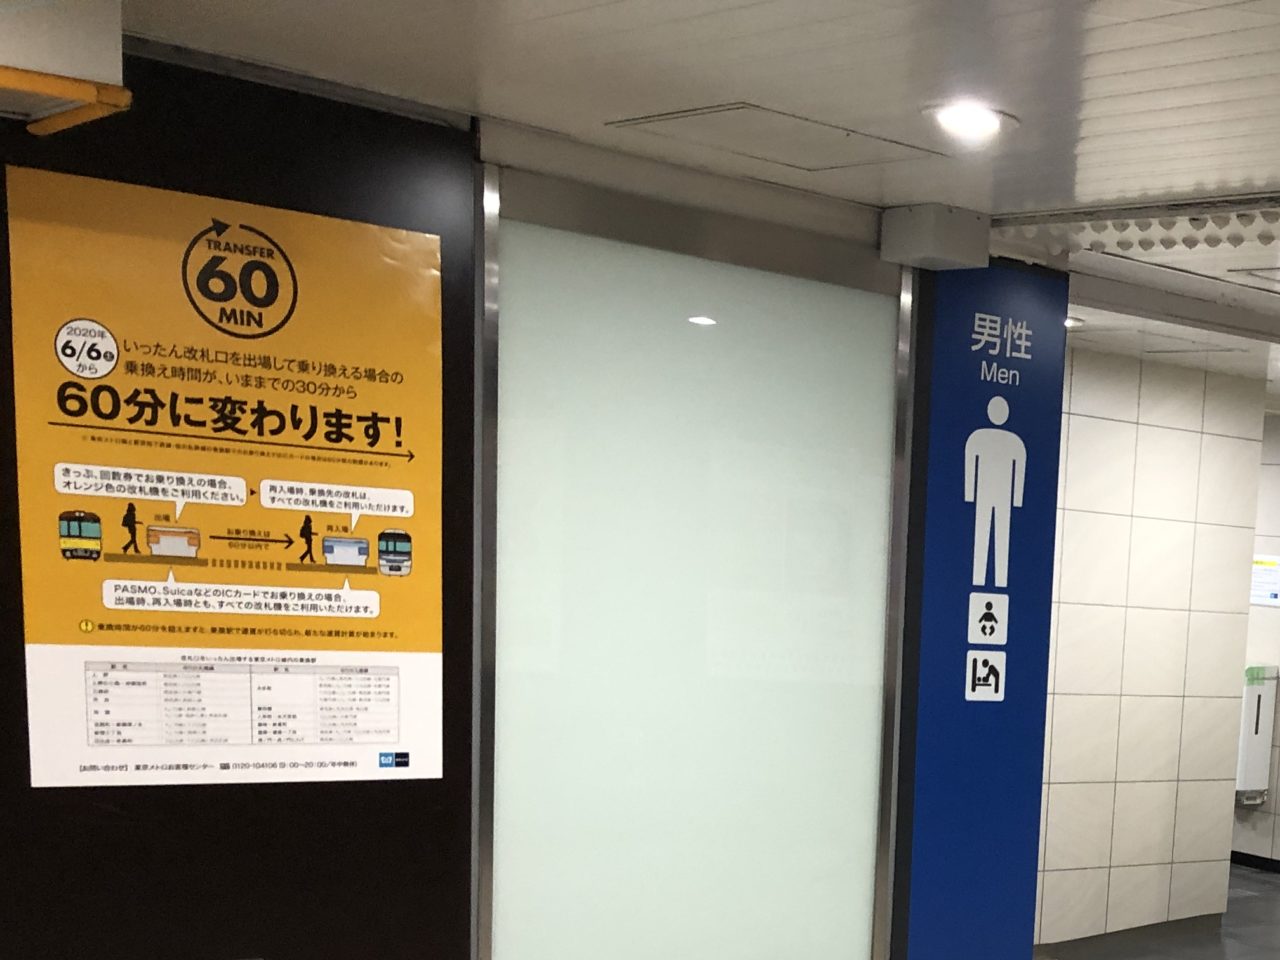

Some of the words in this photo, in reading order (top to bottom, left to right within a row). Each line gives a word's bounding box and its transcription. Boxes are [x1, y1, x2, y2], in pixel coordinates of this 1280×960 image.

[206, 239, 274, 259] TRANSFER
[197, 255, 279, 308] 60
[219, 307, 263, 328] MIN
[971, 312, 1033, 359] 男性
[76, 362, 98, 375] から
[123, 339, 404, 385] いったん改札口を出場して乗り換える場合の
[980, 360, 1020, 386] Men
[124, 360, 358, 400] 乗換え時間が、いままでの30分から
[57, 380, 403, 448] 60分に変わります!
[63, 480, 245, 503] オレンジ色の改札機をご利用ください。
